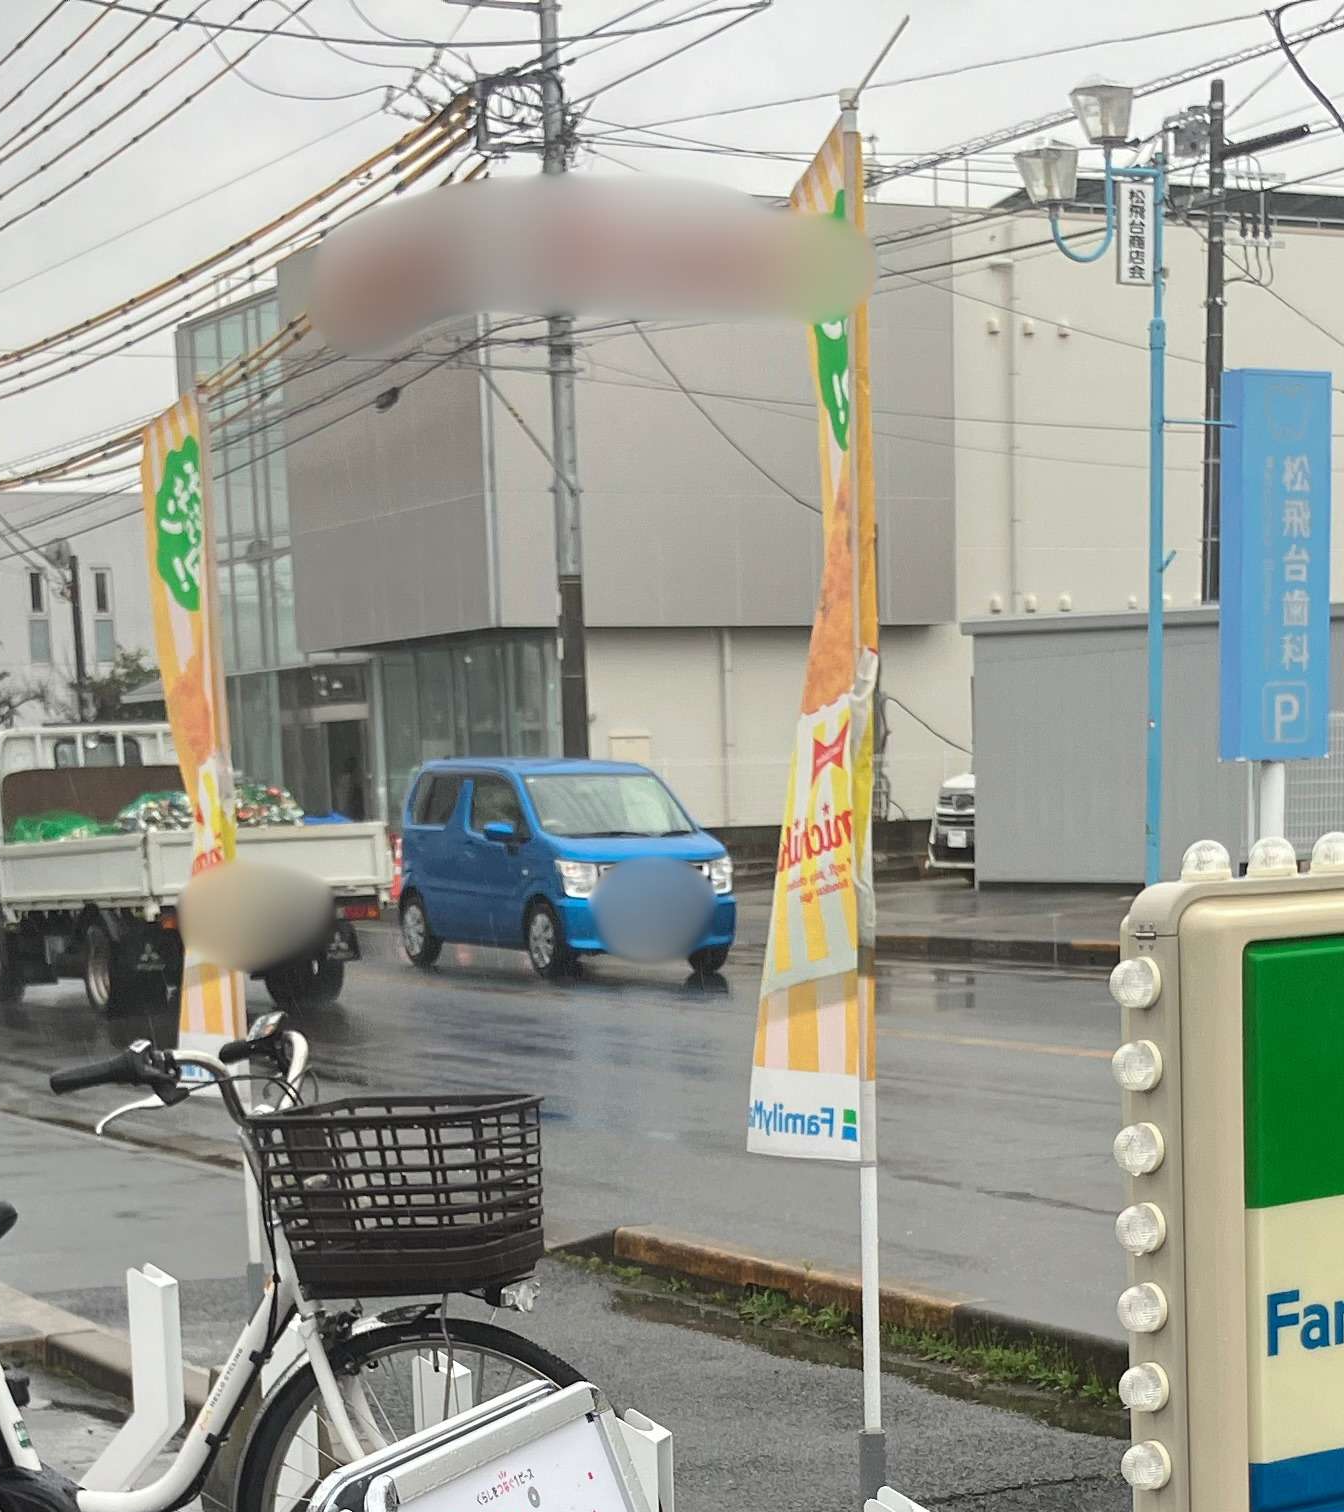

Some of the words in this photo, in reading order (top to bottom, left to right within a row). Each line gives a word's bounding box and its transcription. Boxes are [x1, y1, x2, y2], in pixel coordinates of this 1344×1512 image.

[1129, 190, 1145, 280] 松飛台商店会
[1282, 455, 1311, 672] 松飛台歯科
[1274, 694, 1300, 742] P
